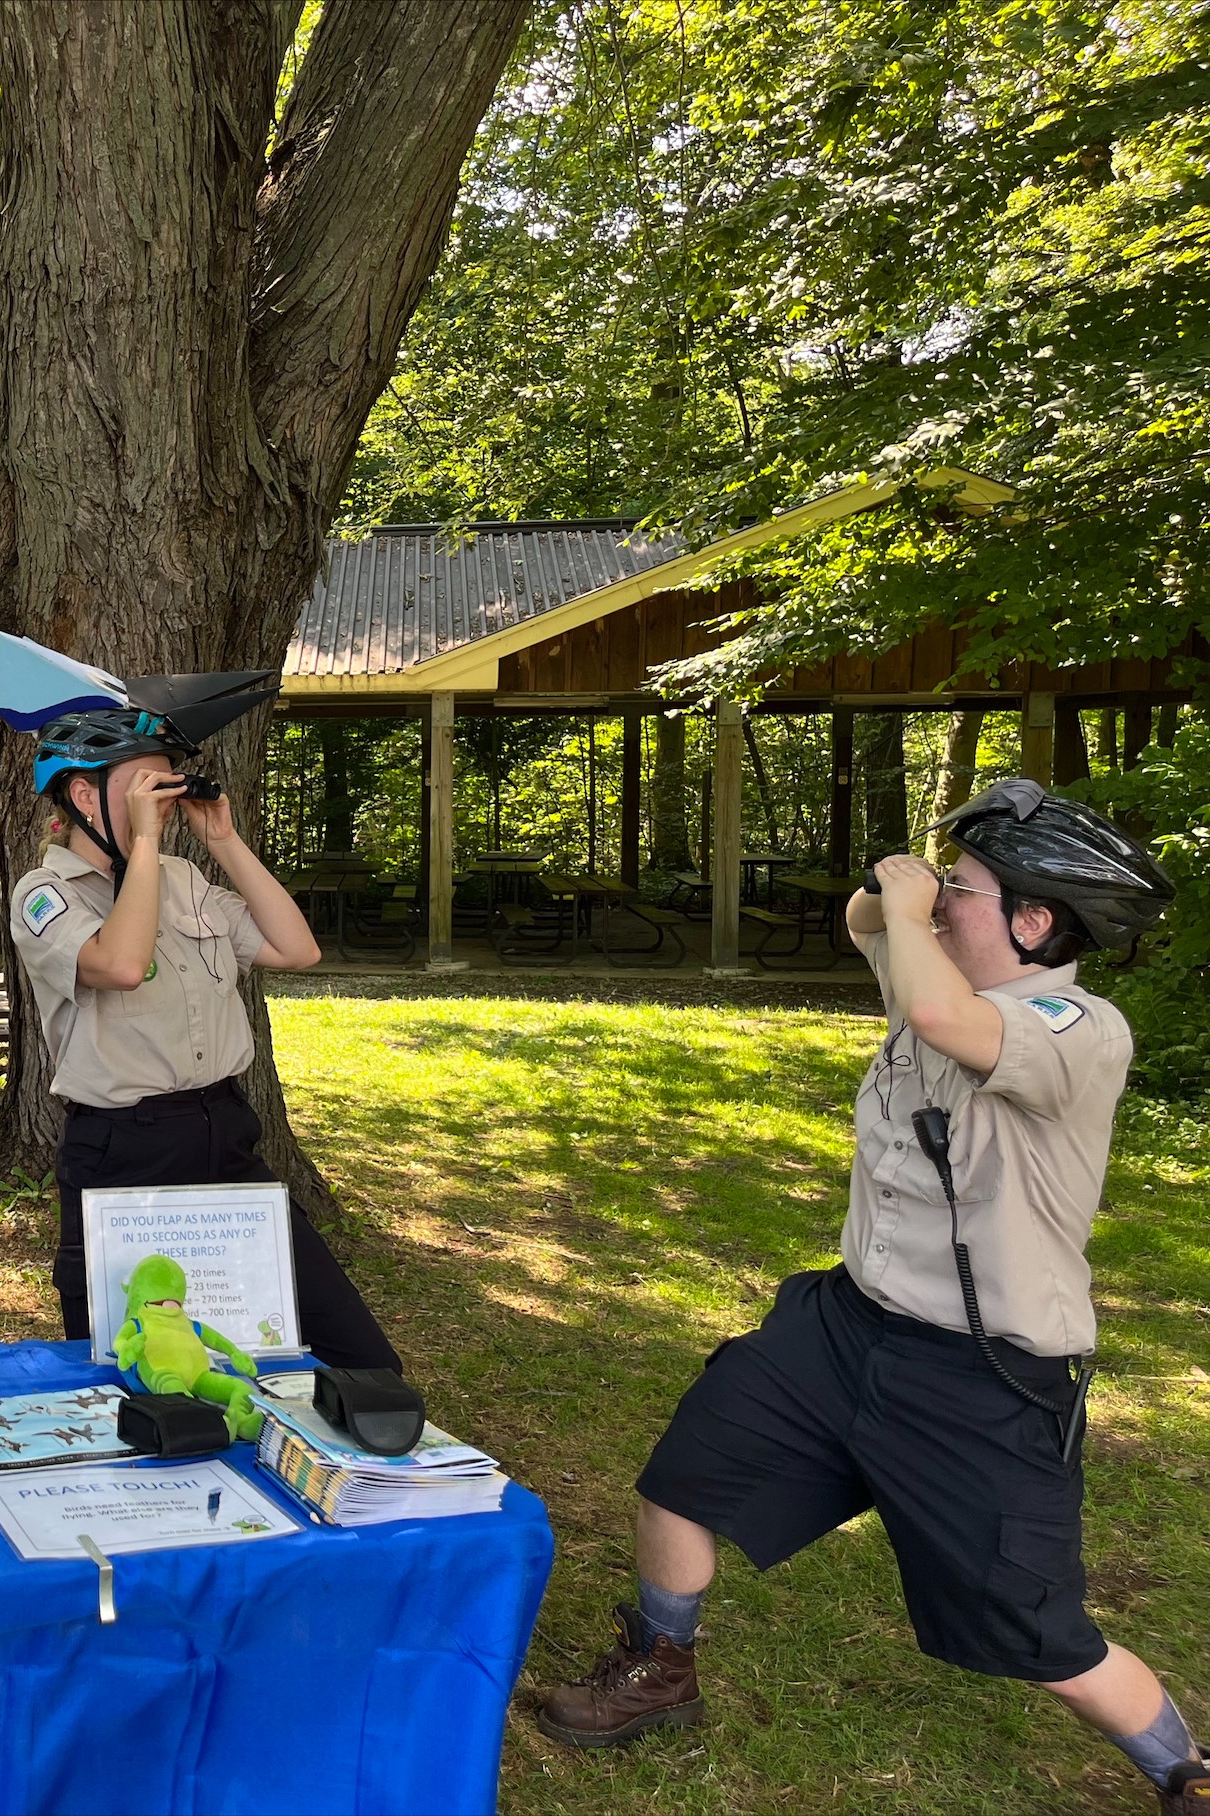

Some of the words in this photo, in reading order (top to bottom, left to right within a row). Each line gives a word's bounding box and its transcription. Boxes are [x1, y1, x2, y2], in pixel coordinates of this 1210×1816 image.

[110, 1217, 129, 1227] DID
[132, 1216, 154, 1226] YOU
[157, 1215, 182, 1225] FLAP
[184, 1214, 197, 1224] AS
[201, 1213, 232, 1224] MANY
[234, 1212, 267, 1222] TIMES
[122, 1234, 134, 1243] IN
[138, 1232, 150, 1242] 10
[152, 1231, 201, 1242] SECONDS
[204, 1230, 216, 1240] AS
[219, 1230, 240, 1239] ANY
[243, 1228, 257, 1238] OF
[156, 1248, 188, 1258] THESE
[191, 1246, 227, 1257] BIRDS?
[191, 1269, 201, 1278] 20
[203, 1269, 226, 1278] times
[194, 1282, 204, 1291] 23
[206, 1282, 229, 1290] times
[202, 1295, 217, 1304] 270
[219, 1294, 242, 1303] times
[208, 1308, 224, 1317] 700
[227, 1307, 249, 1316] times
[18, 1482, 105, 1499] PLEASE
[107, 1479, 201, 1493] TOUCH!
